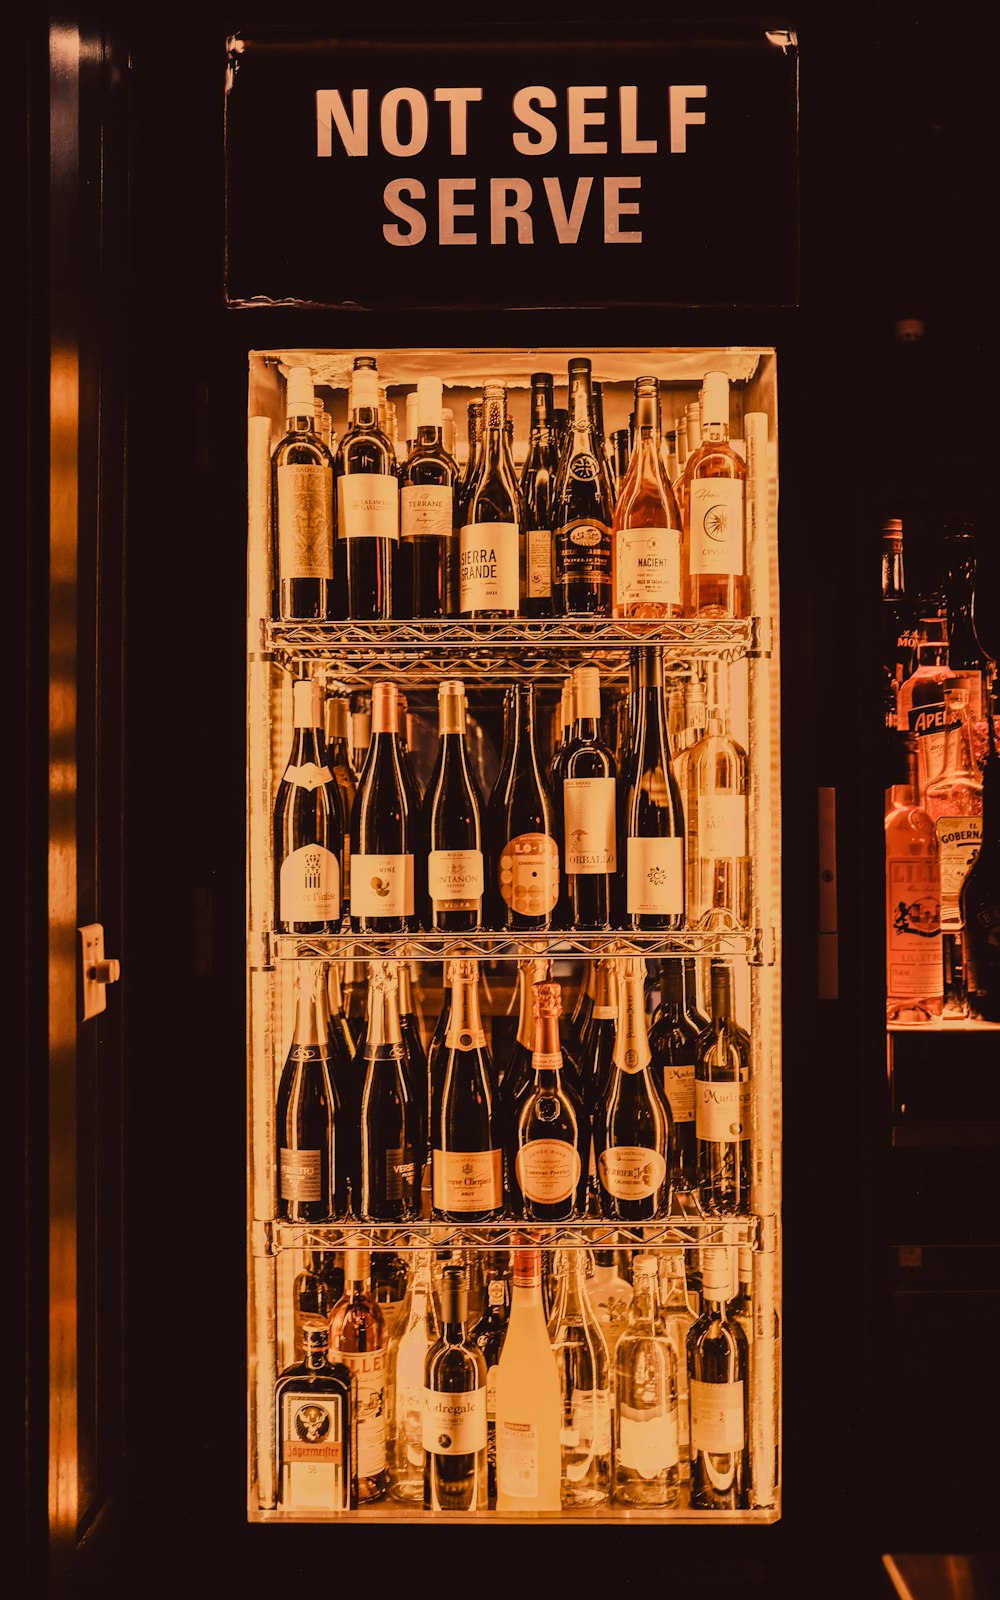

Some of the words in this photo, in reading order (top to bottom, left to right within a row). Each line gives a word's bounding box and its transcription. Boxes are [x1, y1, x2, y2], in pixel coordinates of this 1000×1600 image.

[316, 86, 483, 158] NOT
[512, 84, 707, 156] SELF
[382, 176, 643, 247] SERVE
[409, 500, 443, 508] TERRANE
[461, 548, 497, 566] SIERRA
